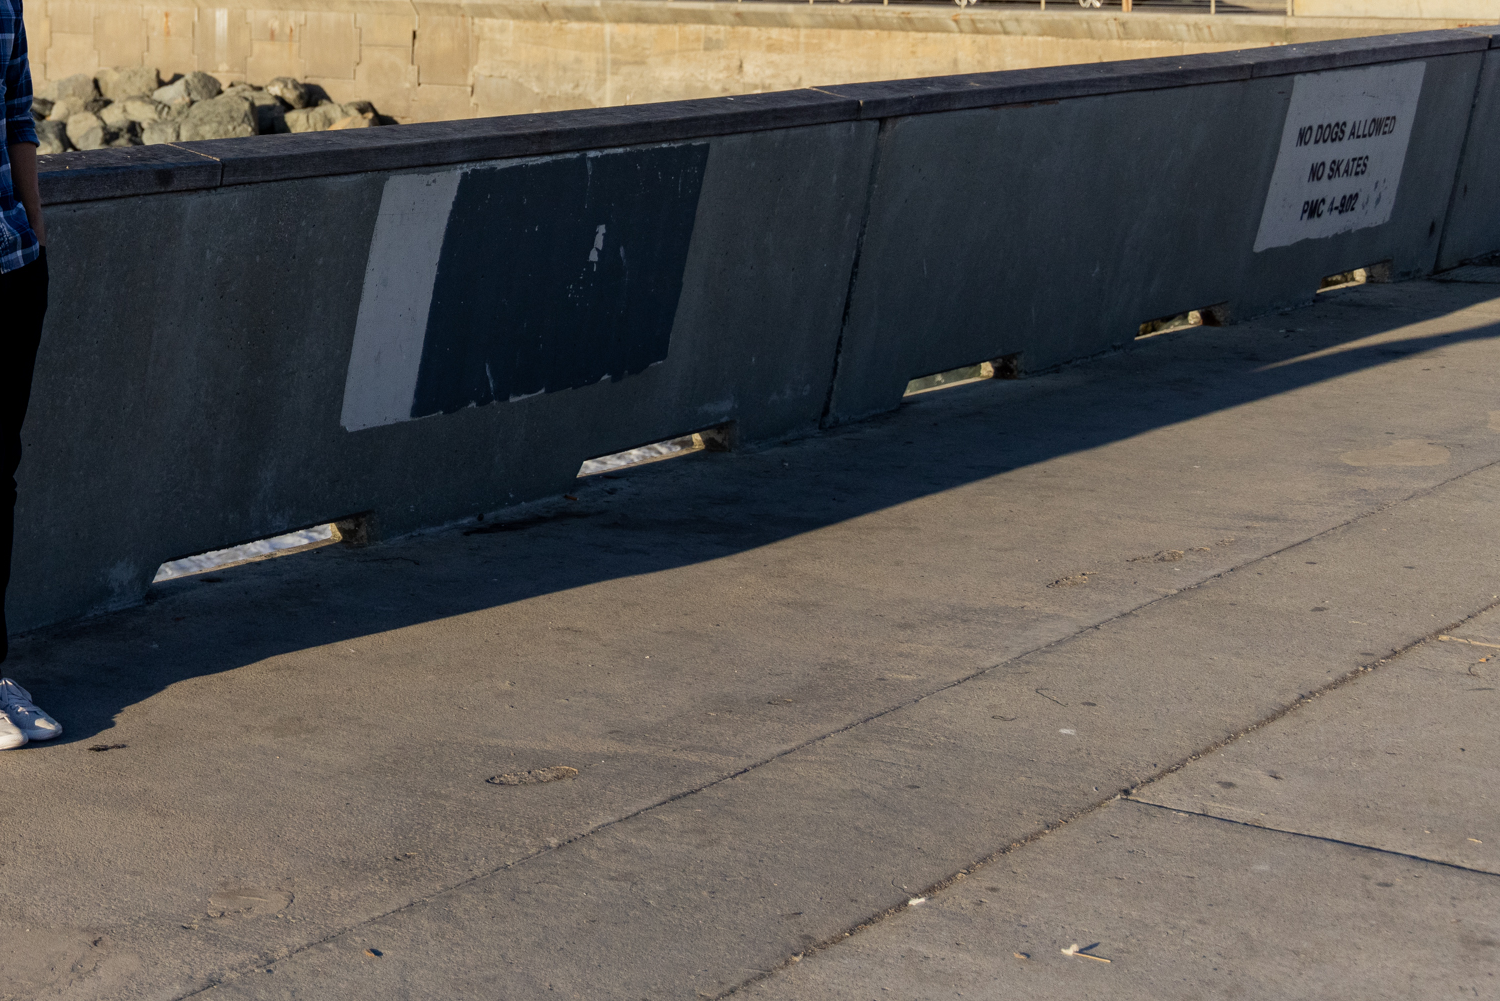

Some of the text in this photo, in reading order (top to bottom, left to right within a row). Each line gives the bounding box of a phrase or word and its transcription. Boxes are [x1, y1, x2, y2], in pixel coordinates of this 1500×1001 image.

[1296, 115, 1397, 147] NO DOGS ALLOWED
[1307, 155, 1369, 183] NO SKATES
[1300, 197, 1326, 221] PMC
